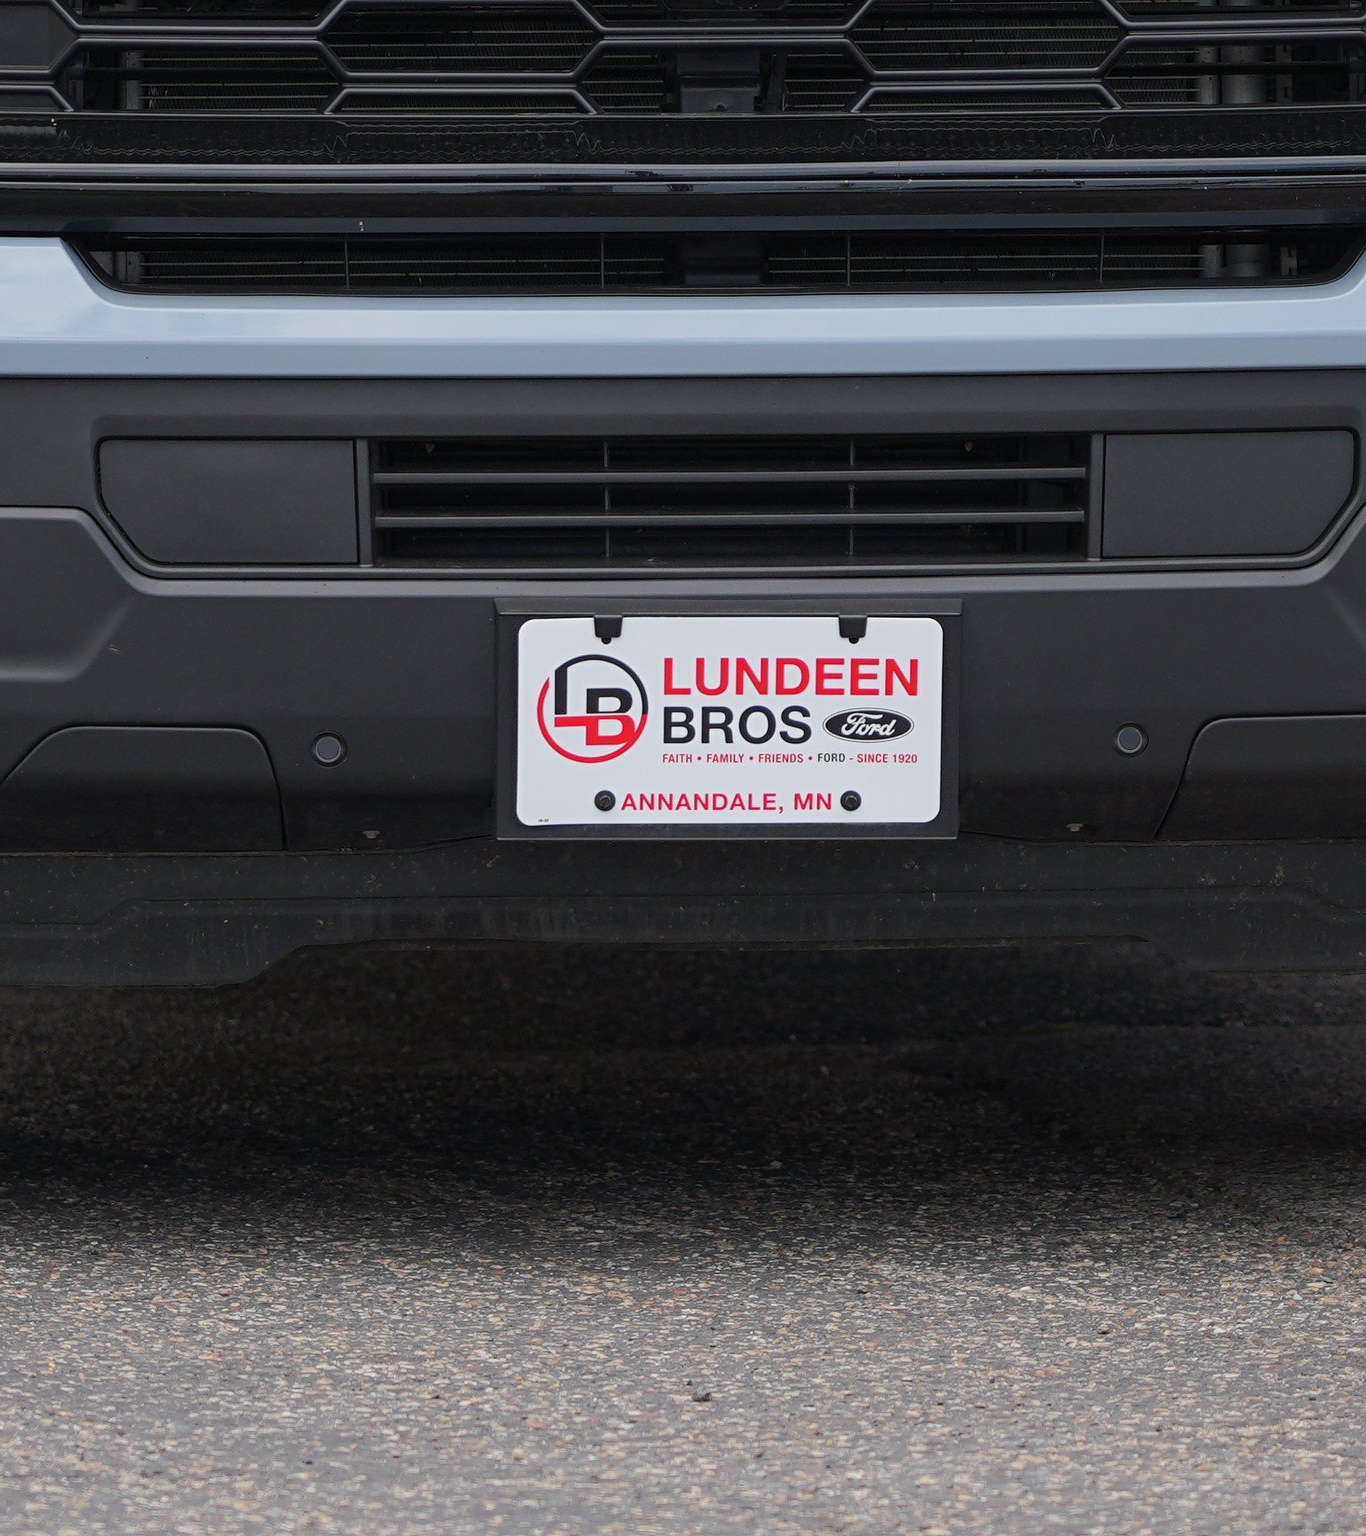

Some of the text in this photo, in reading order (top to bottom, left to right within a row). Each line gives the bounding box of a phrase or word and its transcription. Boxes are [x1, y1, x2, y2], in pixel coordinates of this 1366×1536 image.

[663, 657, 919, 697] LUNDEEN
[663, 705, 812, 745] BROS
[841, 712, 897, 736] Ford
[662, 752, 918, 764] FAITH FAMILY FRIENDS FORD SINCE 1920
[620, 792, 832, 814] ANNANDALE, MN
